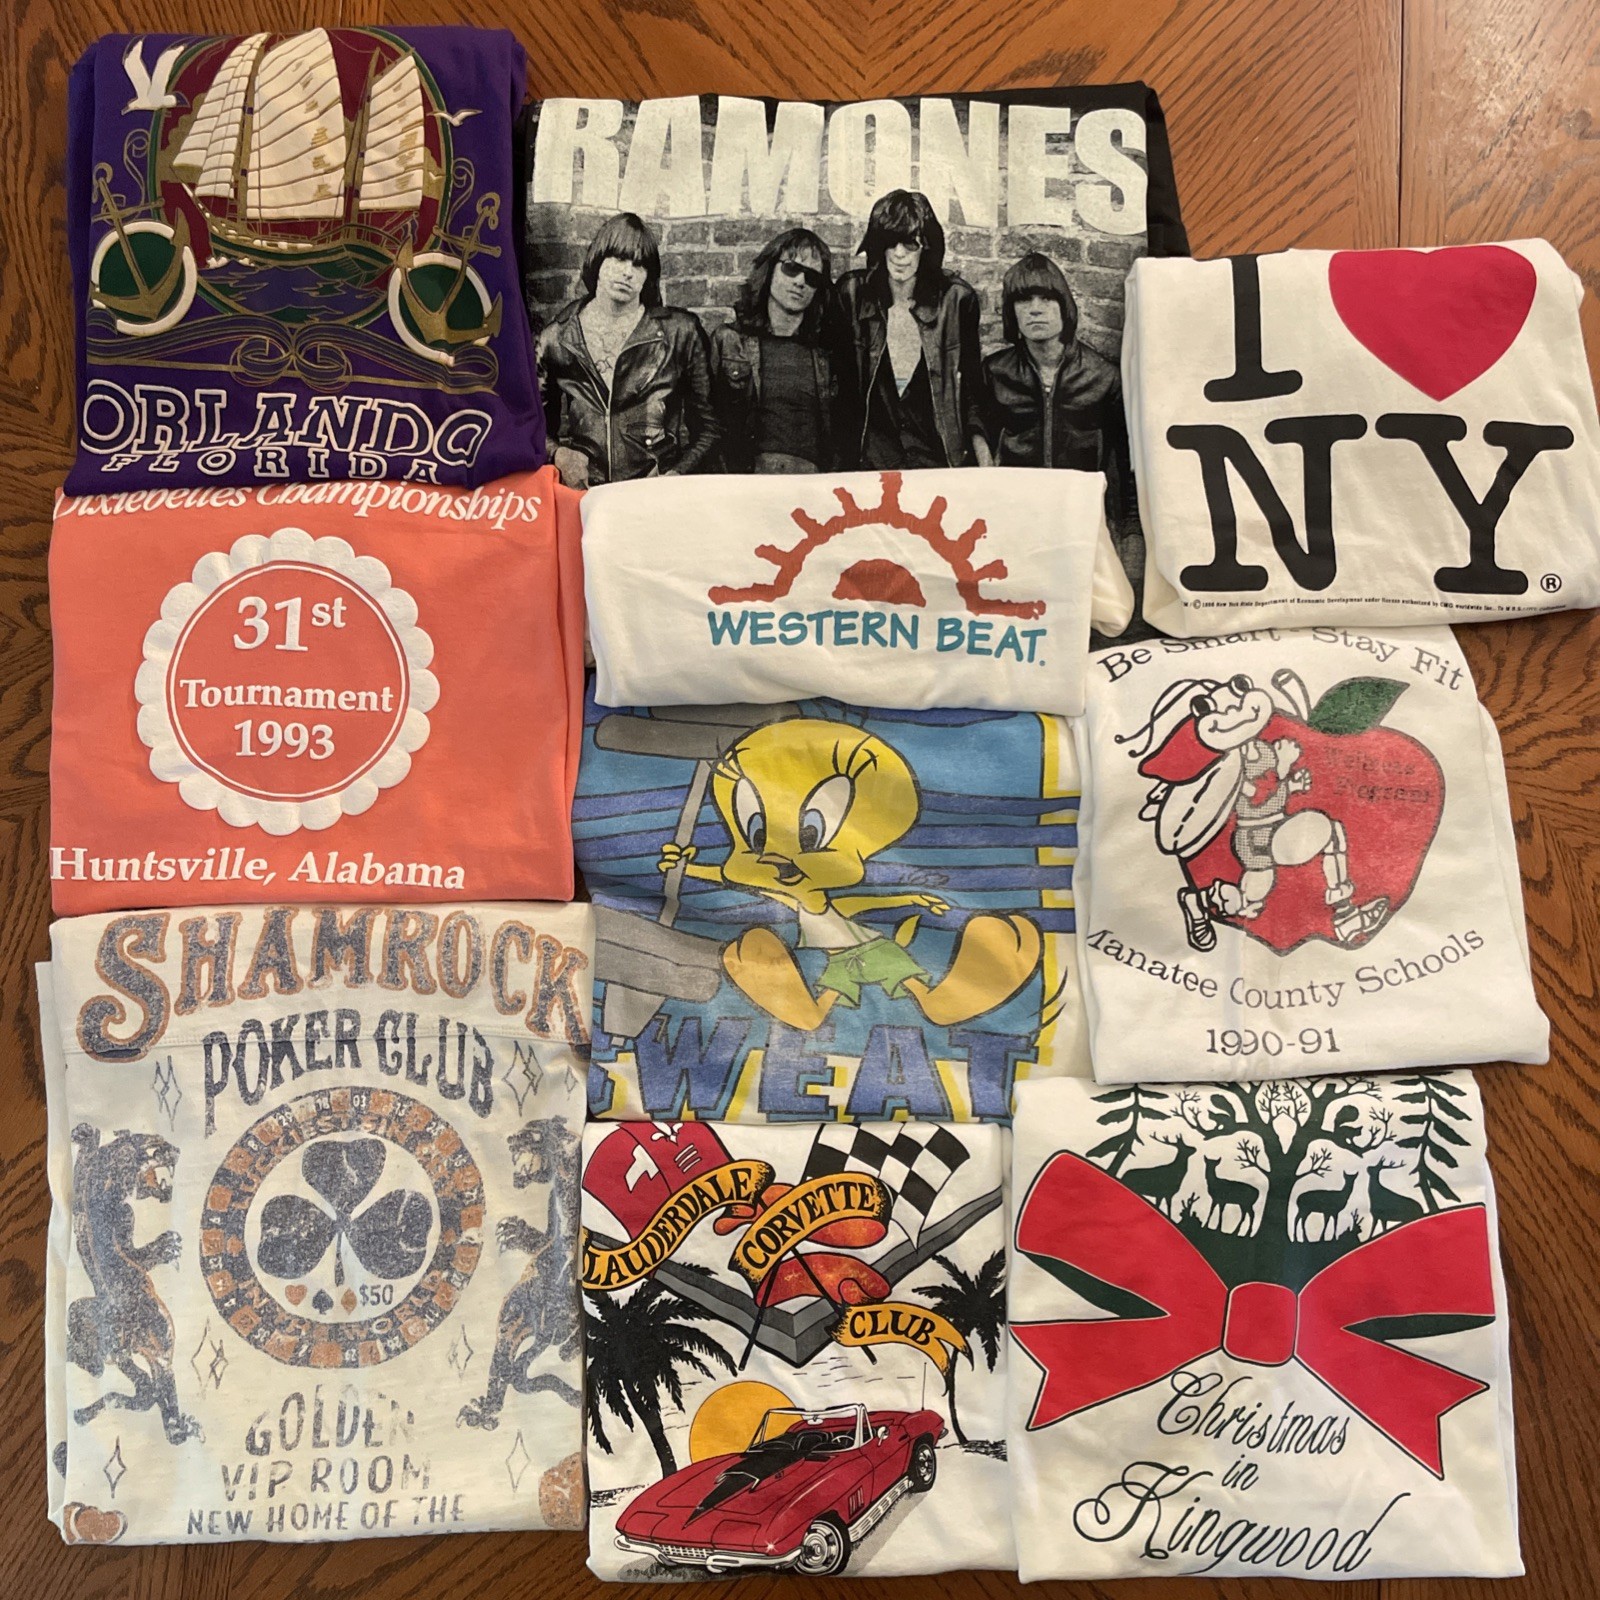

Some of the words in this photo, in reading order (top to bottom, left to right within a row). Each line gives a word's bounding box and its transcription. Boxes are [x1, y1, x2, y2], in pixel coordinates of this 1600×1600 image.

[533, 95, 1148, 236] RAMONES
[1204, 255, 1303, 402] I
[81, 379, 492, 469] ORLANDO
[102, 447, 442, 486] FLORIDA
[256, 482, 541, 530] Championships
[1166, 413, 1575, 595] NY
[233, 596, 347, 652] 31st
[707, 610, 919, 650] WESTERN
[1097, 648, 1152, 683] Be
[1160, 628, 1280, 654] Smart
[1312, 626, 1400, 662] Stay
[1410, 647, 1463, 691] Fit
[180, 680, 393, 713] Tournament
[234, 720, 335, 760] 1993
[50, 847, 276, 886] Huntsville,
[288, 851, 466, 890] Alabama
[77, 907, 591, 1062] SHAMROCK
[1230, 977, 1346, 1009] County
[1355, 930, 1484, 994] Schools
[1205, 1028, 1340, 1057] 1990-91
[203, 1008, 362, 1139] POKER
[373, 1009, 494, 1119] CLUB
[583, 1168, 752, 1286] LAUDERDALE
[742, 1181, 875, 1269] CORVETTE
[359, 1284, 394, 1307] $50
[849, 1309, 936, 1345] CLUB
[245, 1383, 415, 1457] GOLDEN
[1157, 1371, 1351, 1455] Christmas
[221, 1460, 293, 1501] VIP
[310, 1453, 431, 1495] ROOM
[1221, 1454, 1258, 1491] in
[187, 1509, 253, 1536] NEW
[265, 1501, 350, 1533] HOME
[360, 1500, 399, 1530] OF
[411, 1494, 466, 1526] THE
[1073, 1461, 1411, 1575] Kingwood
